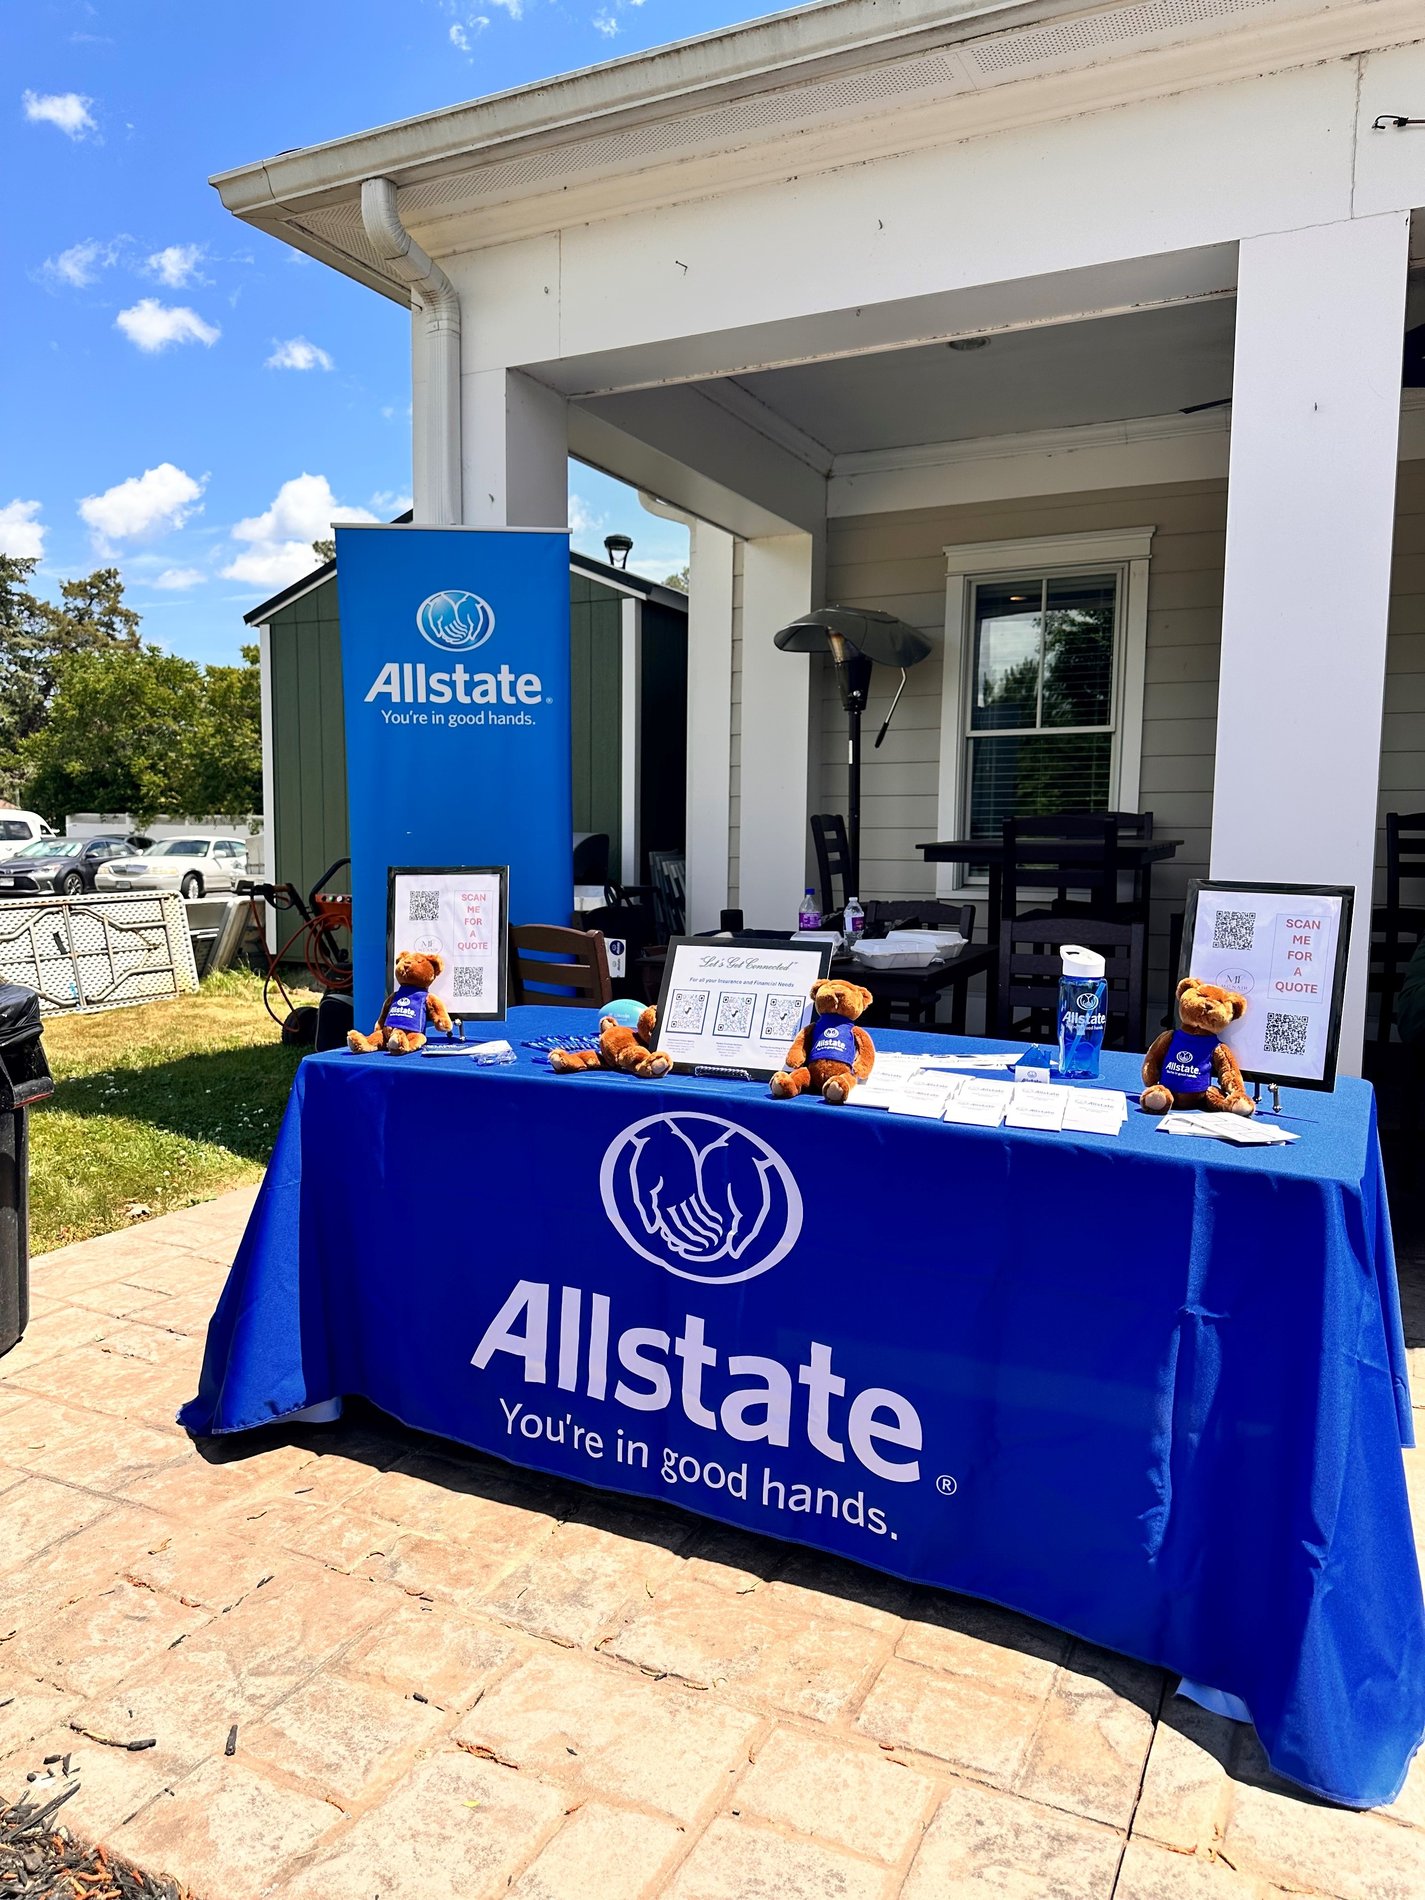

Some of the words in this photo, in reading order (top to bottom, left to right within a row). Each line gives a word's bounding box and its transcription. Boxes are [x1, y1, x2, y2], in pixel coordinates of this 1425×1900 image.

[364, 662, 542, 705] Allstate
[381, 709, 428, 725] You're
[432, 710, 445, 725] in
[448, 711, 484, 727] good
[488, 710, 536, 726] hands.
[1286, 918, 1321, 930] SCAN
[457, 942, 488, 951] QUOTE
[1292, 935, 1311, 945] ME
[1287, 950, 1313, 961] FOR
[727, 956, 745, 969] Get
[1293, 967, 1302, 976] A
[1275, 981, 1318, 994] QUOTE
[1062, 1011, 1106, 1024] Allstate
[1165, 1061, 1200, 1075] Allstate
[469, 1279, 923, 1483] Allstate
[499, 1398, 604, 1459] You're
[616, 1429, 648, 1469] in
[660, 1448, 748, 1502] good
[762, 1468, 899, 1541] hands.
